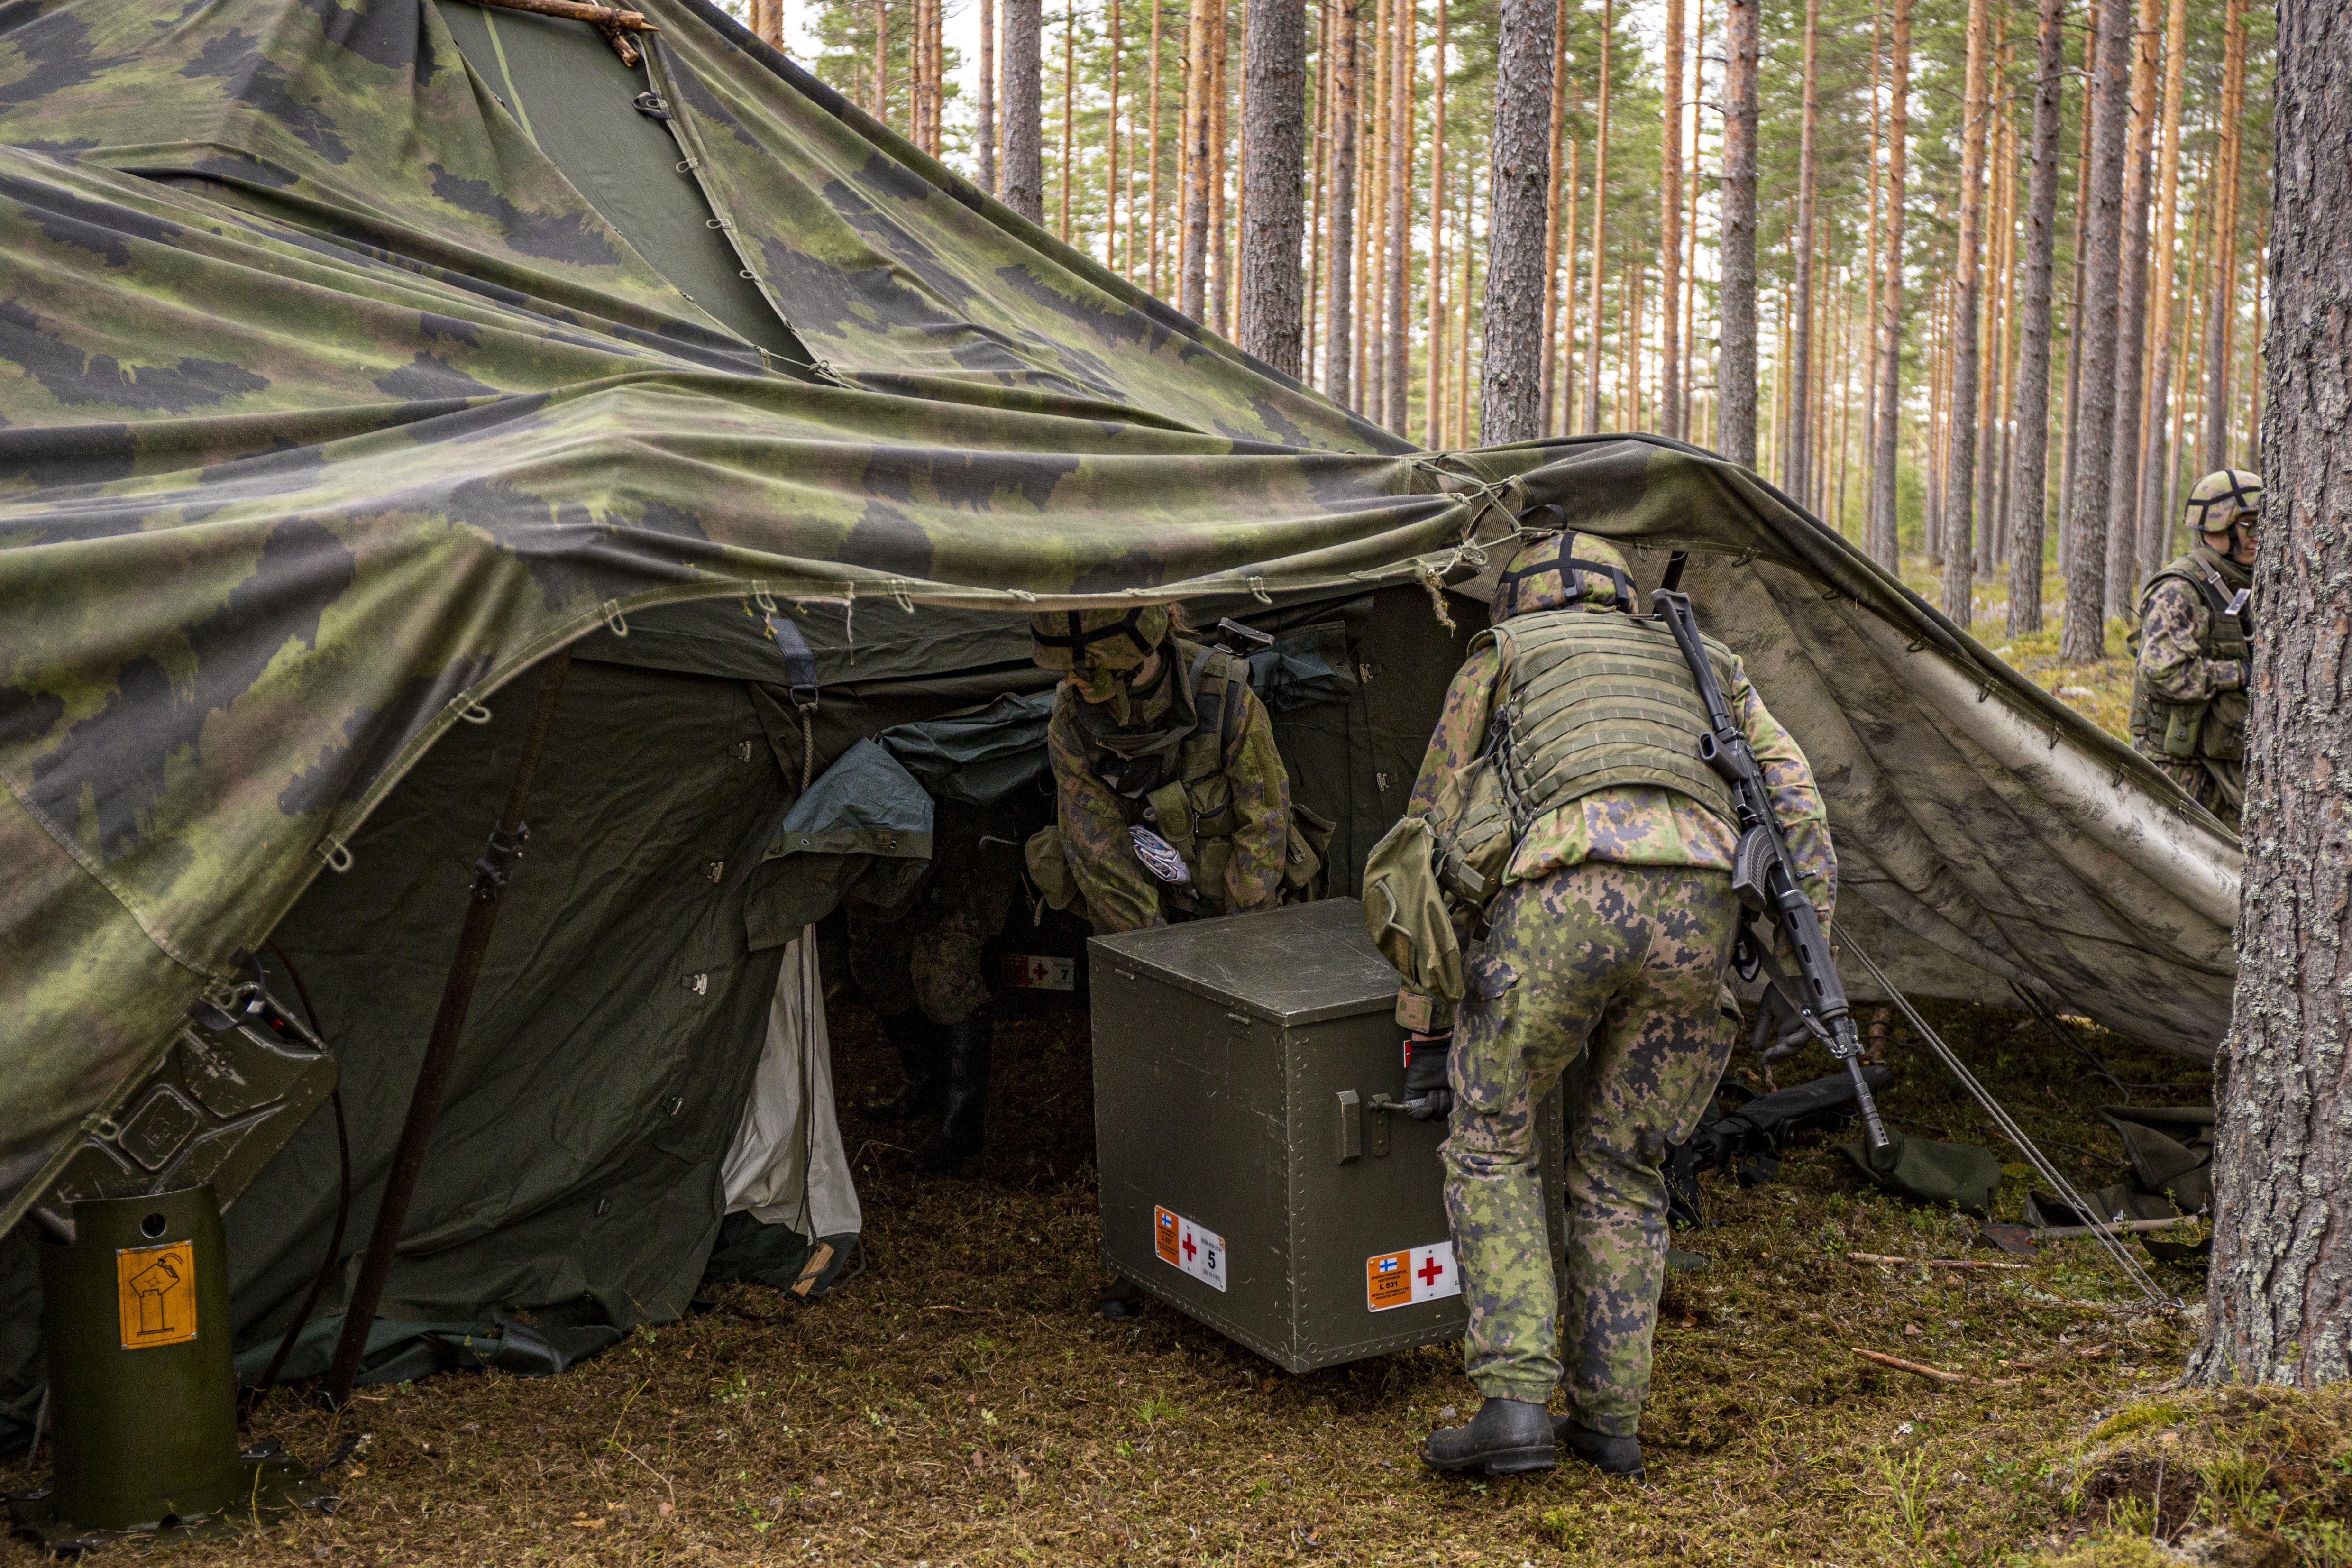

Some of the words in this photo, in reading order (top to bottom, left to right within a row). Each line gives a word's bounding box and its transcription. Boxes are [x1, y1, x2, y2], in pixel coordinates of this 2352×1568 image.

[1061, 969, 1069, 980] 7
[1208, 1249, 1216, 1269] 5
[1386, 1281, 1398, 1289] 531
